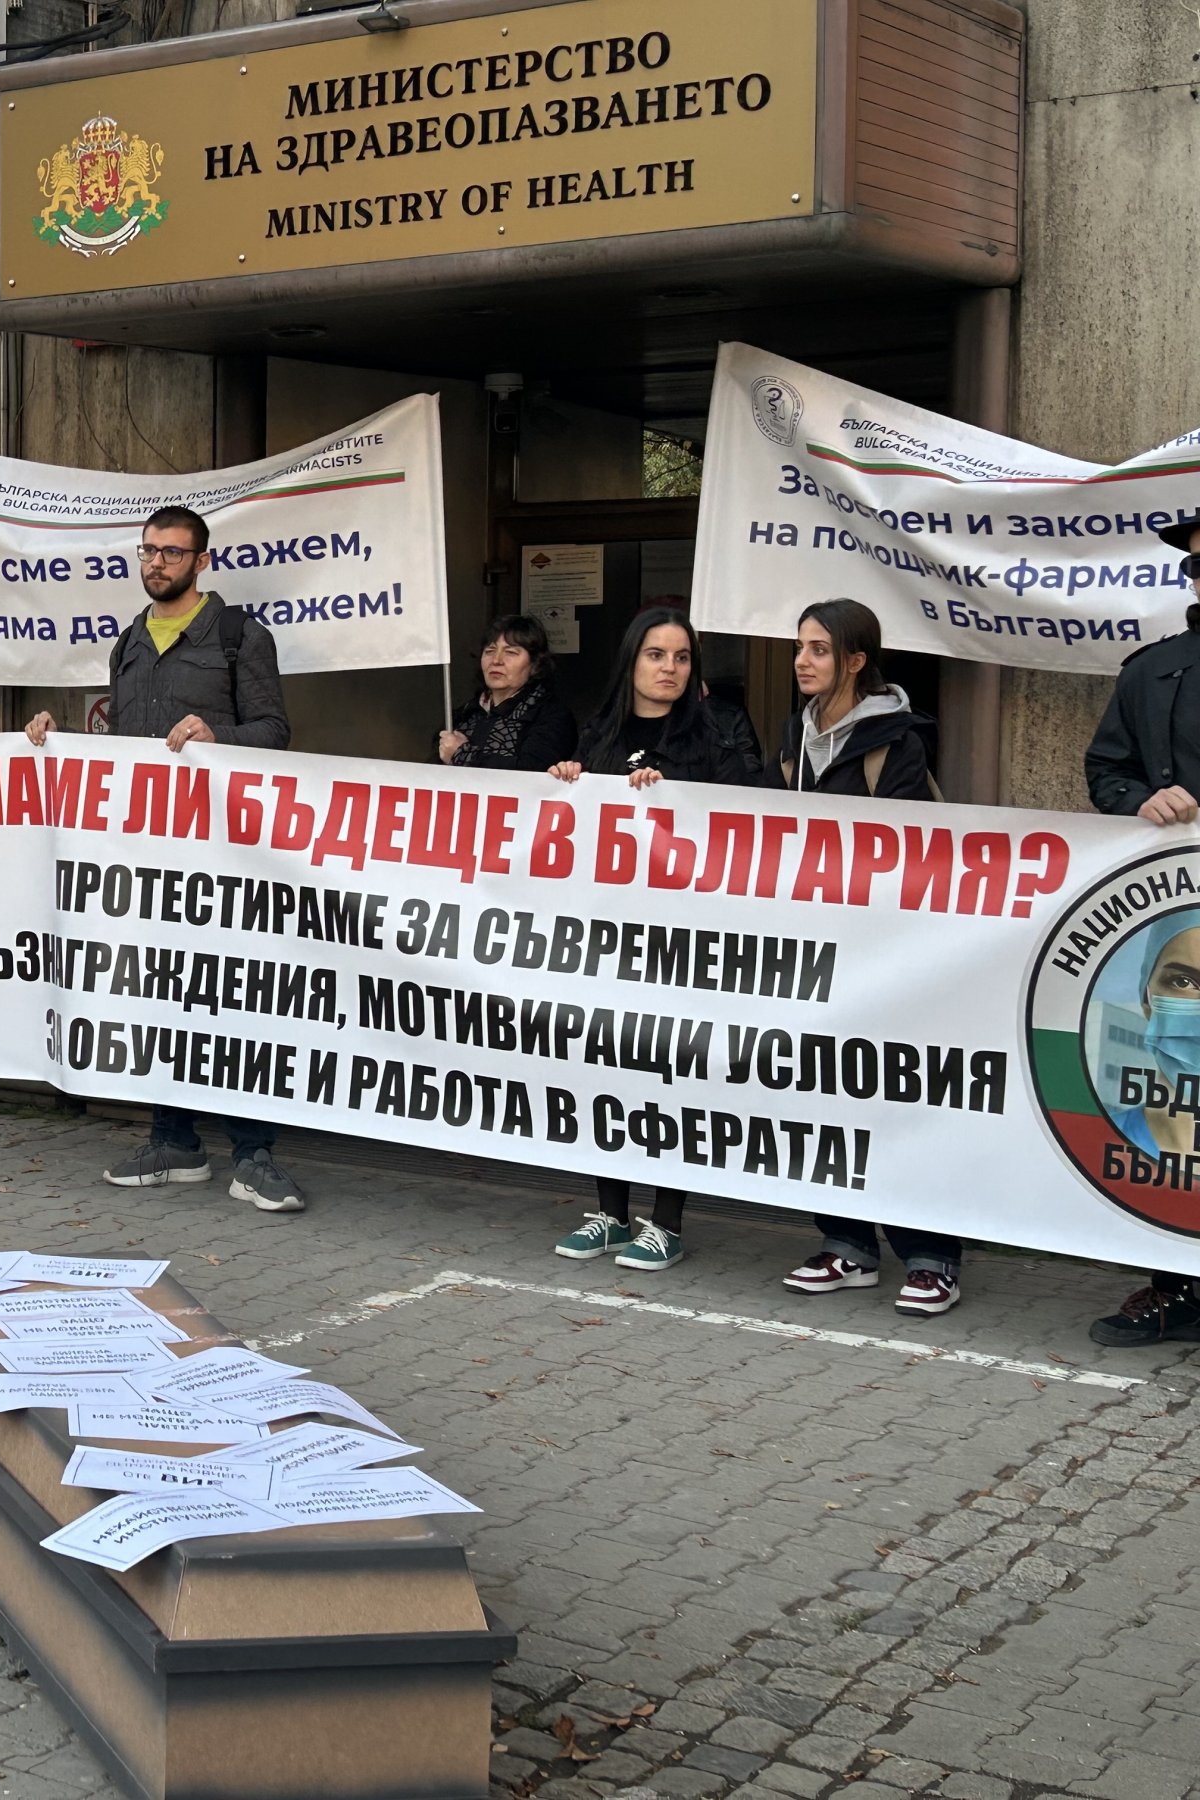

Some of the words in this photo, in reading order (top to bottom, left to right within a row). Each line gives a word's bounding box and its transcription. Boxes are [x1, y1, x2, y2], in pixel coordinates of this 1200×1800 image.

[285, 31, 670, 118] МИНИСТЕРСТВО
[204, 142, 262, 180] НА
[276, 73, 772, 175] ЗДРАВЕОПАЗВАНЕТО
[265, 189, 448, 239] MINISTRY
[461, 180, 513, 215] OF
[526, 158, 695, 208] HEALTH
[839, 418, 928, 450] БЪЛГАРСКА
[931, 447, 1042, 478] АСОЦИАЦИЯ
[854, 436, 941, 463] BULGARIAN
[2, 498, 81, 515] BULGARIAN
[71, 493, 160, 506] АСОЦИАЦИЯ
[163, 494, 184, 503] НА
[749, 520, 798, 547] на
[778, 465, 820, 497] За
[823, 484, 953, 534] достоен
[966, 512, 993, 536] и
[1, 557, 71, 582] сме
[84, 555, 129, 581] за
[69, 614, 120, 644] да
[245, 583, 403, 627] кажем!
[920, 599, 938, 620] в
[946, 600, 1142, 646] България
[122, 763, 210, 841] ЛИ
[227, 771, 519, 884] БЪДЕЩЕ
[530, 799, 575, 879] В
[594, 803, 1070, 918] БЪЛГАРИЯ?
[55, 859, 388, 951] ПРОТЕСТИРАМЕ
[397, 897, 461, 959] ЗА
[473, 907, 838, 1003] СЪВРЕМЕННИ
[1051, 866, 1200, 978] НАЦИОНА
[358, 974, 714, 1085] МОТИВИРАЩИ
[726, 1024, 1008, 1116] УСЛОВИЯ
[46, 1008, 63, 1067] ЗА
[67, 1017, 296, 1099] ОБУЧЕНИЕ
[306, 1048, 339, 1104] И
[347, 1054, 533, 1140] РАБОТА
[546, 1085, 579, 1144] В
[592, 1092, 871, 1191] СФЕРАТА!
